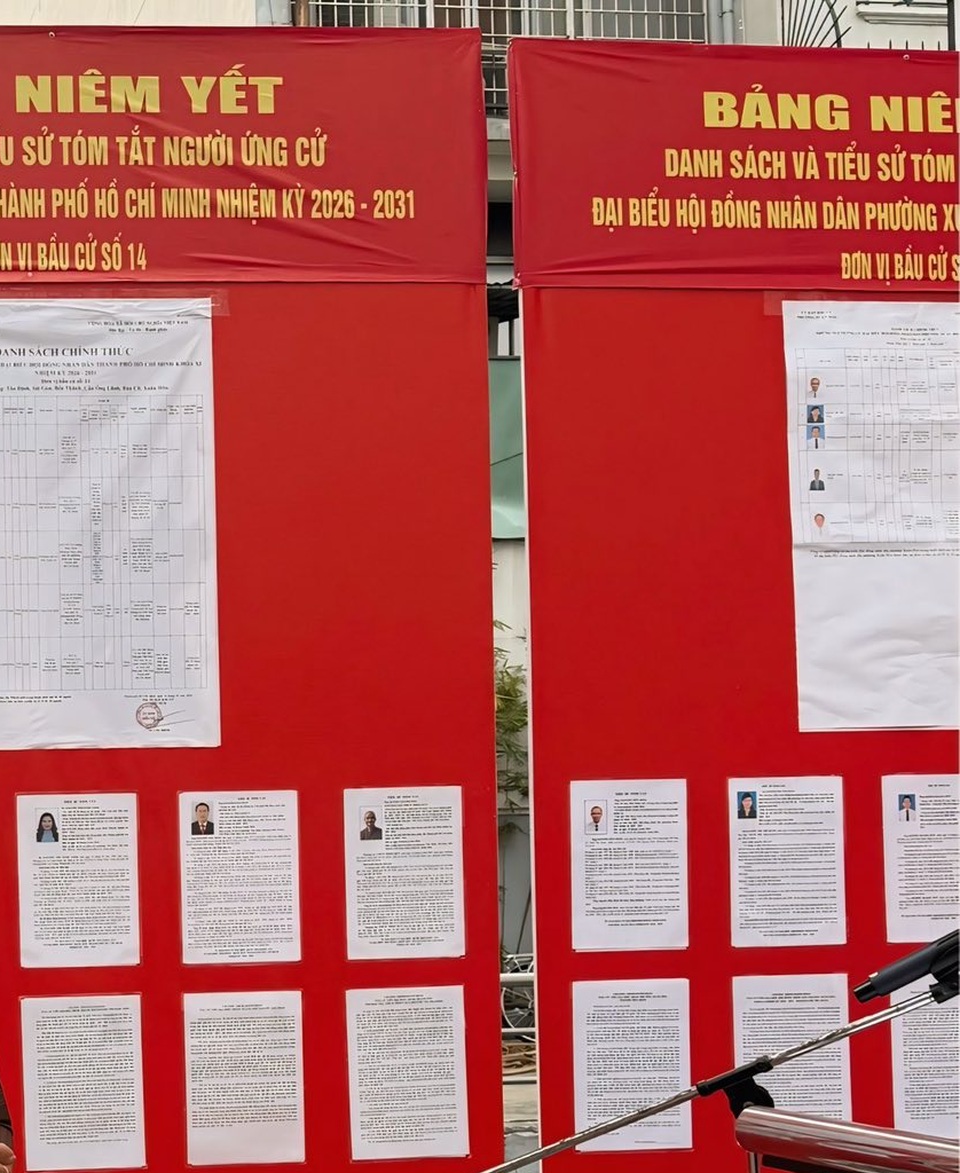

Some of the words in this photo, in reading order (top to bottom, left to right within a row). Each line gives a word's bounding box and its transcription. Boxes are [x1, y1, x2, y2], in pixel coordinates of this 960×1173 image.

[15, 69, 160, 113] NIÊM
[180, 64, 283, 114] YẾT
[703, 84, 849, 130] BẢNG
[870, 91, 959, 133] NIÊ
[22, 126, 54, 166] SỬ
[59, 129, 108, 165] TÓM
[116, 125, 156, 165] TẮT
[164, 129, 233, 166] NGƯỜI
[241, 131, 288, 166] ỨNG
[295, 127, 327, 166] CỬ
[665, 149, 723, 177] DANH
[730, 145, 786, 179] SÁCH
[792, 146, 819, 179] VÀ
[825, 141, 870, 181] TIỂU
[877, 144, 906, 181] SỬ
[911, 148, 955, 182] TÓM
[52, 177, 88, 218] PHỐ
[95, 178, 118, 218] HỒ
[125, 182, 155, 218] CHÍ
[162, 188, 210, 218] MINH
[216, 183, 276, 224] NHIỆM
[283, 183, 305, 218] KỲ
[311, 189, 355, 218] 2026
[373, 190, 414, 219] 2031
[592, 197, 623, 232] ĐẠI
[629, 187, 670, 227] BIỂU
[676, 193, 706, 233] HỘI
[711, 190, 761, 228] ĐỒNG
[767, 195, 817, 228] NHÂN
[823, 196, 859, 229] DÂN
[865, 196, 937, 231] PHƯỜNG
[15, 243, 32, 277] VỊ
[37, 232, 70, 271] BẦU
[73, 232, 97, 271] CỬ
[101, 232, 123, 271] SỐ
[128, 243, 147, 271] 14
[841, 251, 871, 279] ĐƠN
[875, 253, 890, 285] VỊ
[894, 245, 923, 280] BẦU
[928, 246, 948, 281] CỬ
[29, 345, 58, 357] SÁCH
[62, 345, 98, 357] CHÍNH
[101, 345, 134, 357] THỨC
